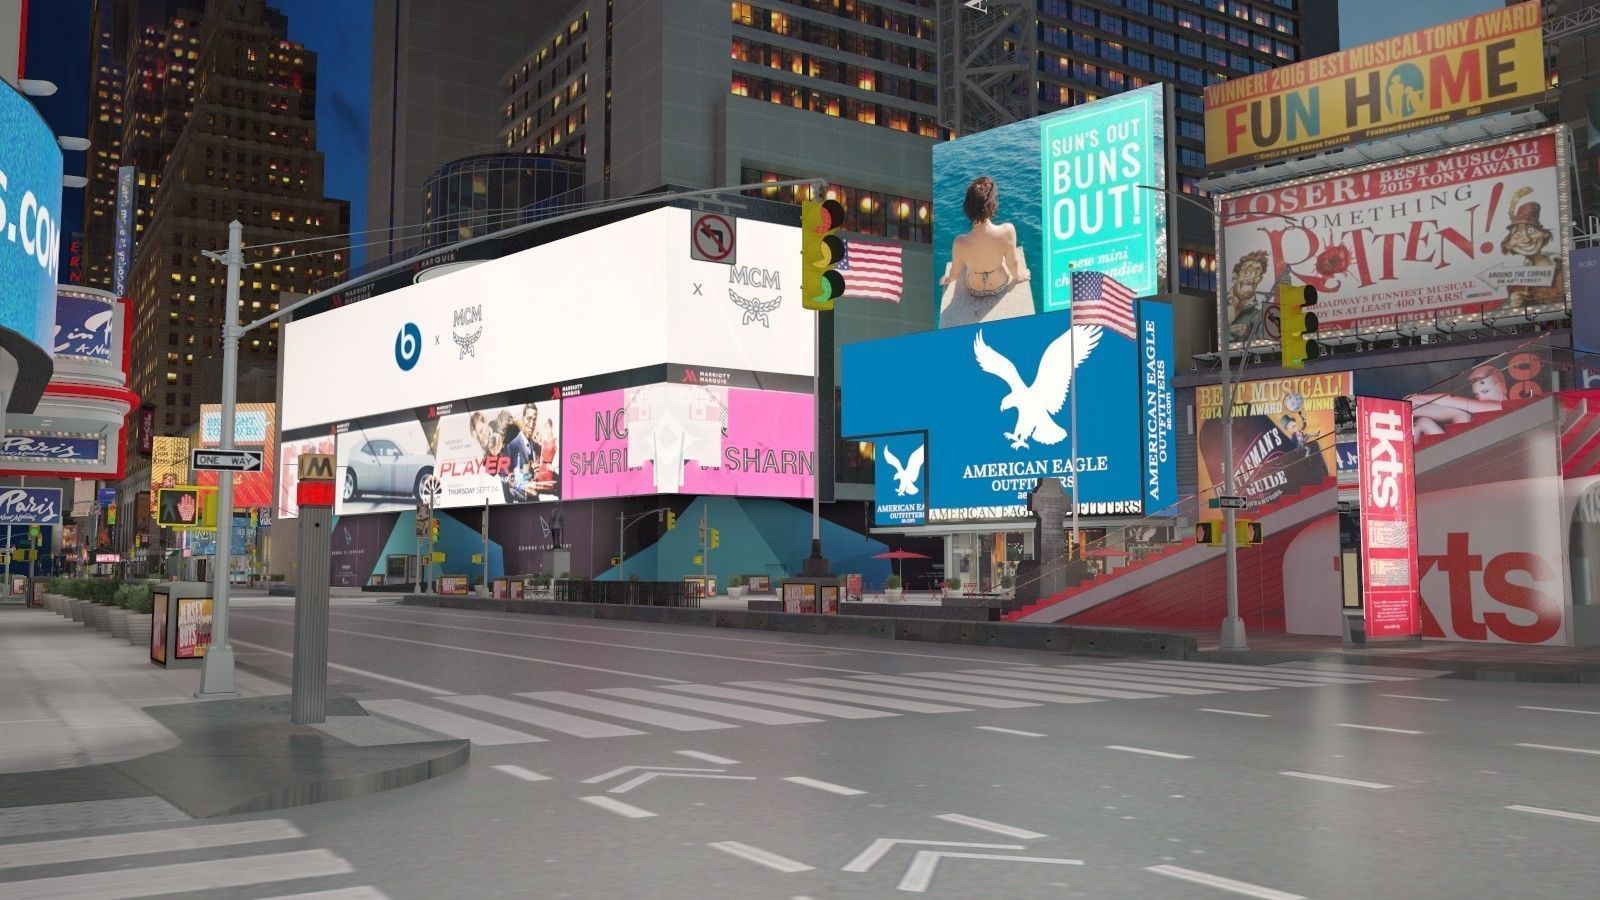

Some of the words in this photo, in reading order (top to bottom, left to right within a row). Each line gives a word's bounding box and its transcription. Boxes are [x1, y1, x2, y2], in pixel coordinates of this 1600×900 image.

[1208, 75, 1268, 107] WINNER!
[1309, 50, 1346, 82] BEST
[1350, 30, 1422, 70] MUSICAL
[1424, 19, 1472, 50] TONY
[1474, 3, 1537, 40] AWARD
[1226, 86, 1321, 155] FUN
[1052, 130, 1099, 158] SUN'S
[1106, 118, 1141, 144] OUT
[1053, 142, 1141, 196] BUNS
[1379, 180, 1412, 195] 2015
[1418, 168, 1467, 188] TONY
[1471, 155, 1540, 178] AWARD
[1380, 163, 1429, 184] BEST
[1436, 141, 1538, 173] MUSICAL!
[1053, 182, 1141, 241] OUT!
[1227, 173, 1370, 223] LOSER!
[1284, 184, 1473, 231] SOMETHING
[1097, 246, 1129, 264] mini
[729, 264, 781, 291] MCM
[1371, 288, 1424, 302] FUNNIEST
[1427, 280, 1477, 295] MUSICAL
[453, 304, 482, 328] MCM
[1332, 308, 1343, 317] IN
[1345, 306, 1358, 316] AT
[1361, 302, 1392, 313] LEAST
[1394, 299, 1415, 310] 400
[1417, 290, 1464, 305] YEARS!
[1145, 320, 1157, 386] EAGLE
[562, 384, 583, 392] MARRIOTT
[699, 371, 730, 379] MARRIOTT
[1251, 375, 1343, 403] MUSICAL!
[1157, 360, 1168, 463] OUTFITTERS
[1250, 402, 1283, 416] AWARD
[2, 436, 83, 458] Paris
[1146, 391, 1160, 500] AMERICAN
[1370, 409, 1404, 509] tkts
[200, 456, 220, 465] ONE
[231, 457, 253, 465] WAY
[440, 455, 512, 478] PLAYER
[963, 461, 1048, 480] AMERICAN
[1052, 456, 1108, 474] EAGLE
[448, 487, 475, 496] THURSDAY
[1247, 470, 1288, 496] GUIDE
[0, 489, 59, 523] Paris
[877, 503, 915, 513] AMERICAN
[930, 507, 1000, 521] AMERICAN
